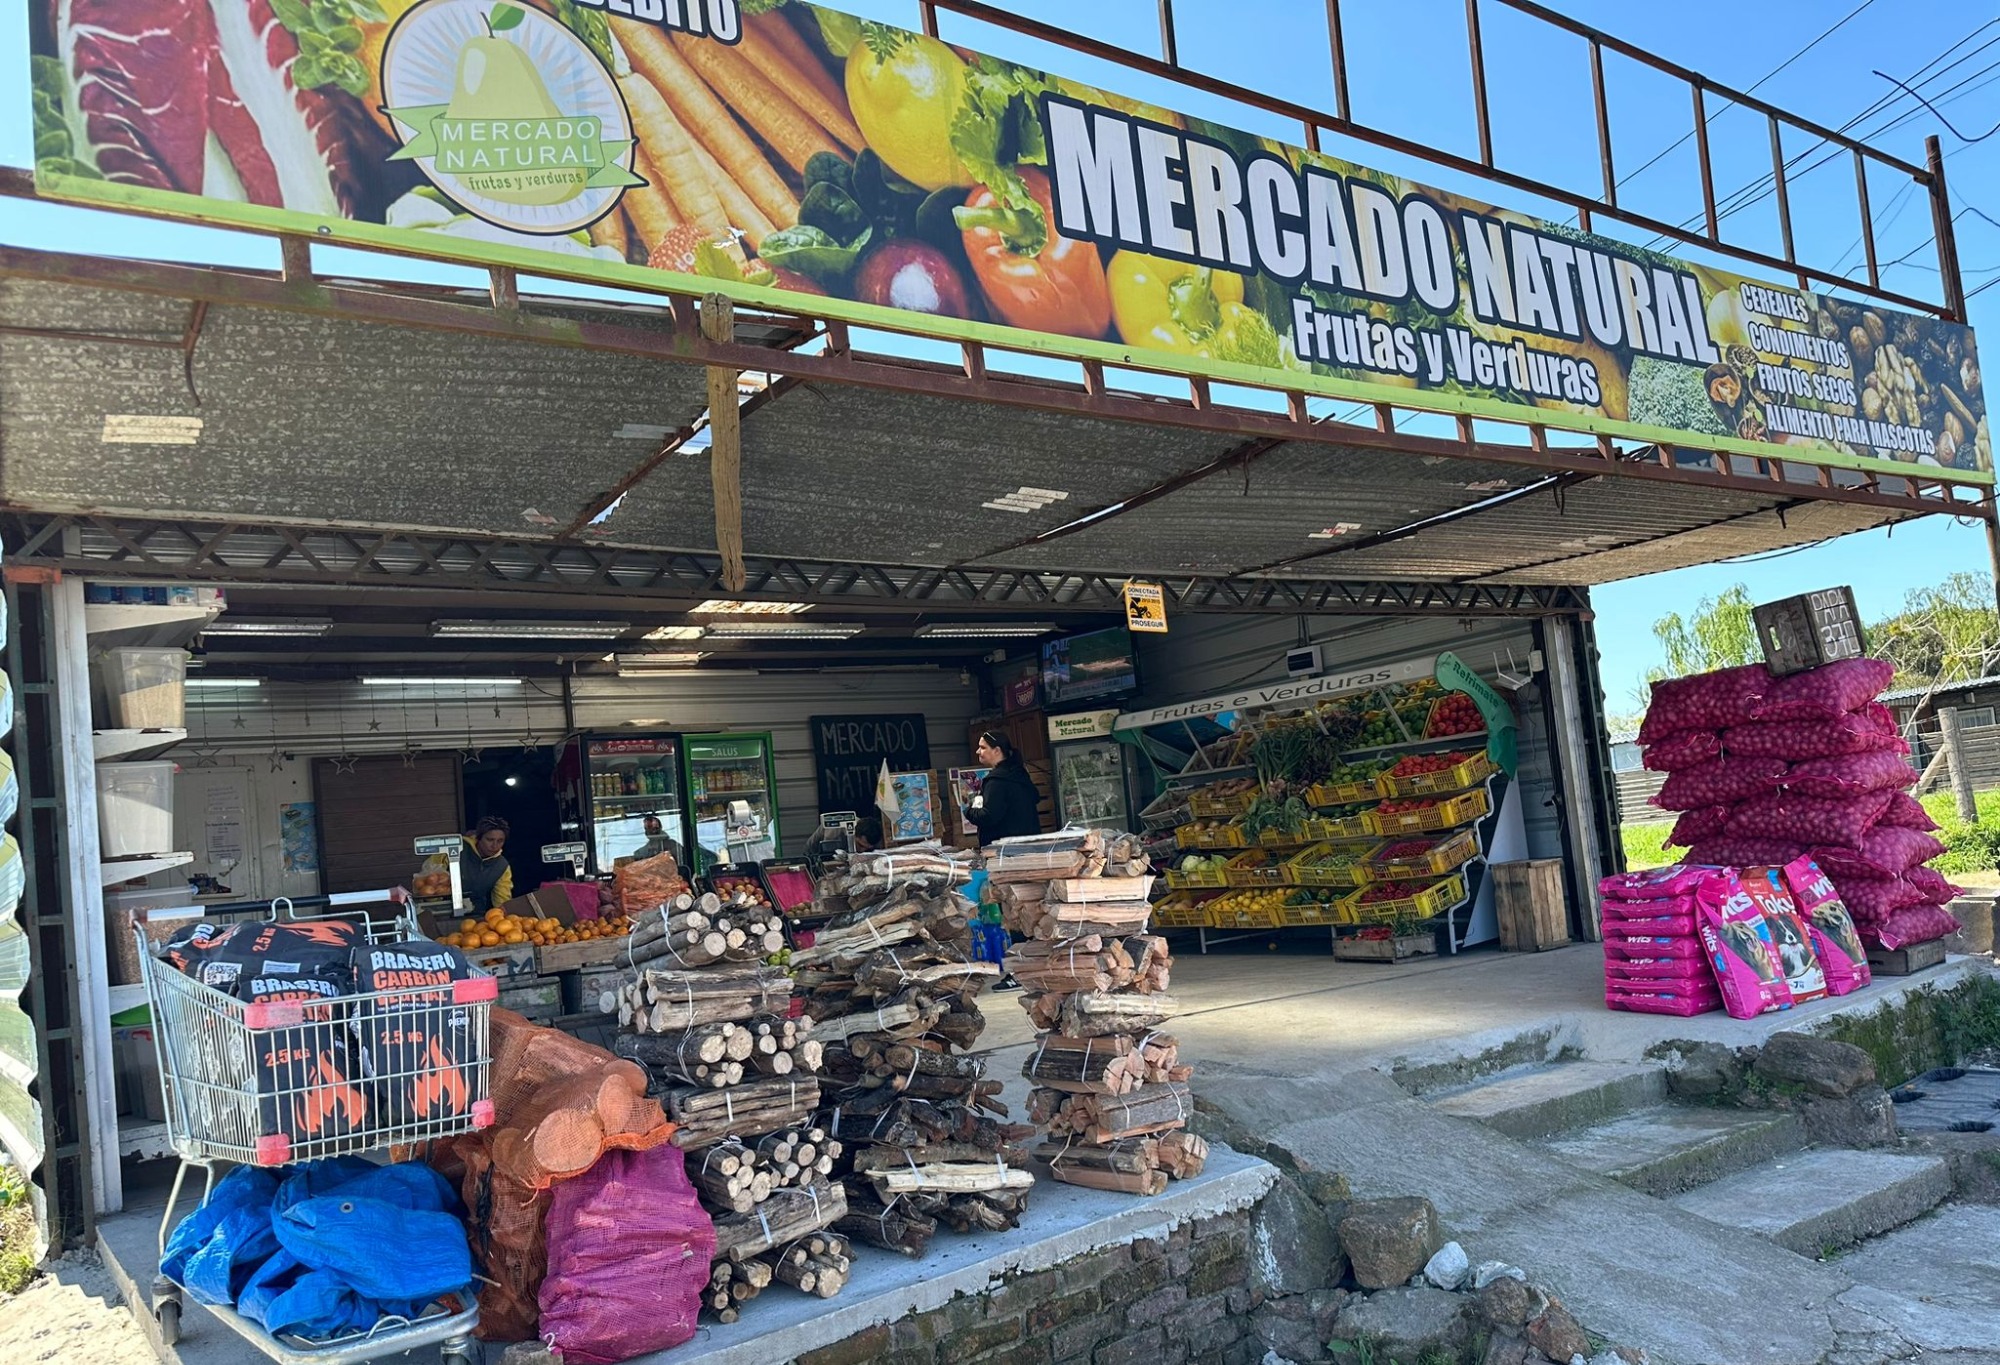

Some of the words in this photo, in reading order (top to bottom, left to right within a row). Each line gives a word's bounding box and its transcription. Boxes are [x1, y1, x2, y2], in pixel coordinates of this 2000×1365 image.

[442, 121, 595, 142] MERCADO
[446, 144, 597, 169] NATURAL
[468, 175, 511, 191] frutas
[514, 177, 522, 191] y
[525, 171, 584, 187] verduras
[1047, 100, 1457, 309] MERCADO
[1462, 214, 1720, 364] NATURAL
[1740, 283, 1809, 324] CEREALES
[1292, 298, 1418, 374] Frutas
[1420, 331, 1444, 383] y
[1446, 326, 1600, 405] Verduras
[1748, 322, 1850, 368] CONDIMENTOS
[1756, 363, 1813, 400] FRUTOS
[1812, 372, 1857, 407] SECOS
[1765, 403, 1834, 441] ALIMENTO
[1834, 415, 1870, 446] PARA
[1869, 421, 1936, 455] MASCOTAS
[1131, 619, 1164, 628] PROSEGUR
[1151, 693, 1223, 722] Frutas
[1228, 693, 1249, 706] e
[1260, 667, 1392, 704] Verduras
[1453, 660, 1500, 708] Refrimate
[1055, 717, 1092, 728] Mercado
[1060, 725, 1096, 736] Natural
[820, 720, 916, 755] MERCADO
[711, 748, 738, 757] SALUS
[370, 951, 456, 972] BRASERO
[373, 969, 451, 989] CARBÓN
[381, 1030, 403, 1045] 2.5
[407, 1030, 423, 1043] KG
[264, 1049, 290, 1068] 2.5
[293, 1048, 311, 1061] KG
